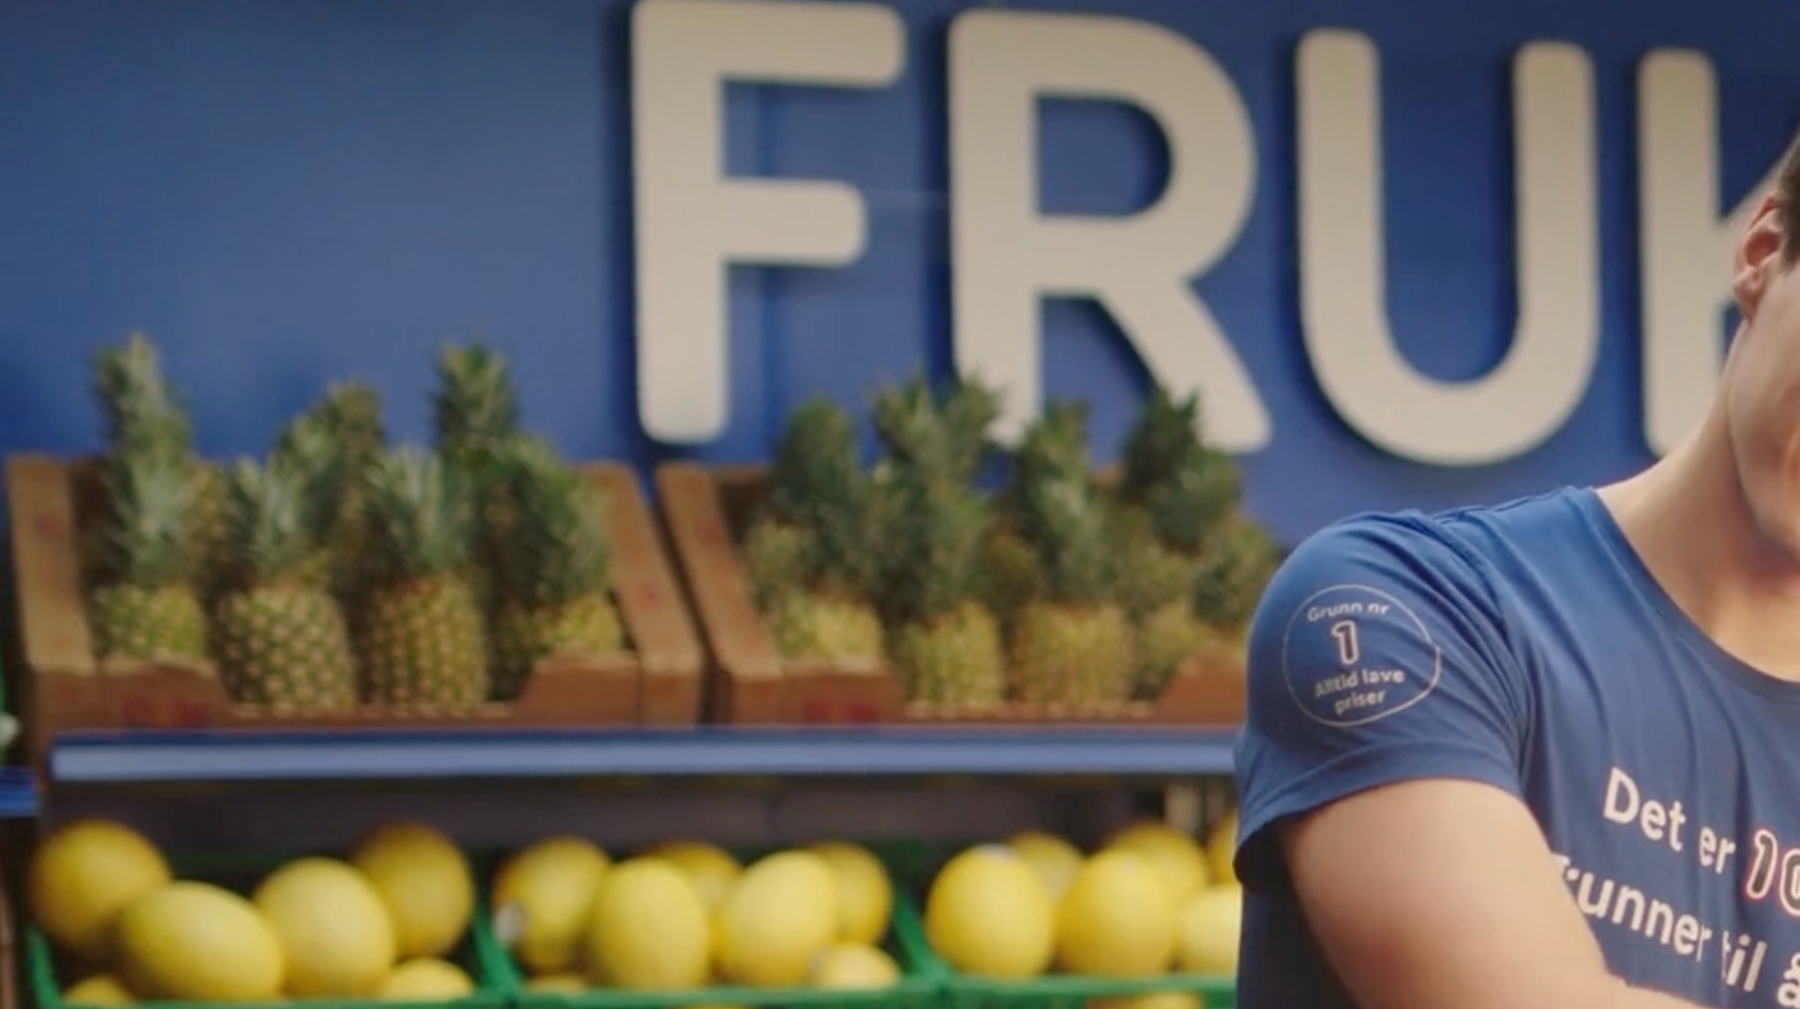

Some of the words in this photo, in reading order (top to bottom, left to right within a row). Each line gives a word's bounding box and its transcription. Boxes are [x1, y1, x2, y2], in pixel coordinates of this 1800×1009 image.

[1307, 602, 1362, 622] Grunn
[1367, 602, 1391, 615] nr
[1331, 619, 1360, 666] 1
[1315, 671, 1358, 698] Alltid
[1362, 668, 1405, 685] lave
[1335, 690, 1386, 716] priser
[1603, 766, 1686, 852] Det
[1699, 826, 1736, 874] er
[1555, 855, 1712, 962] unner
[1721, 930, 1767, 992] til
